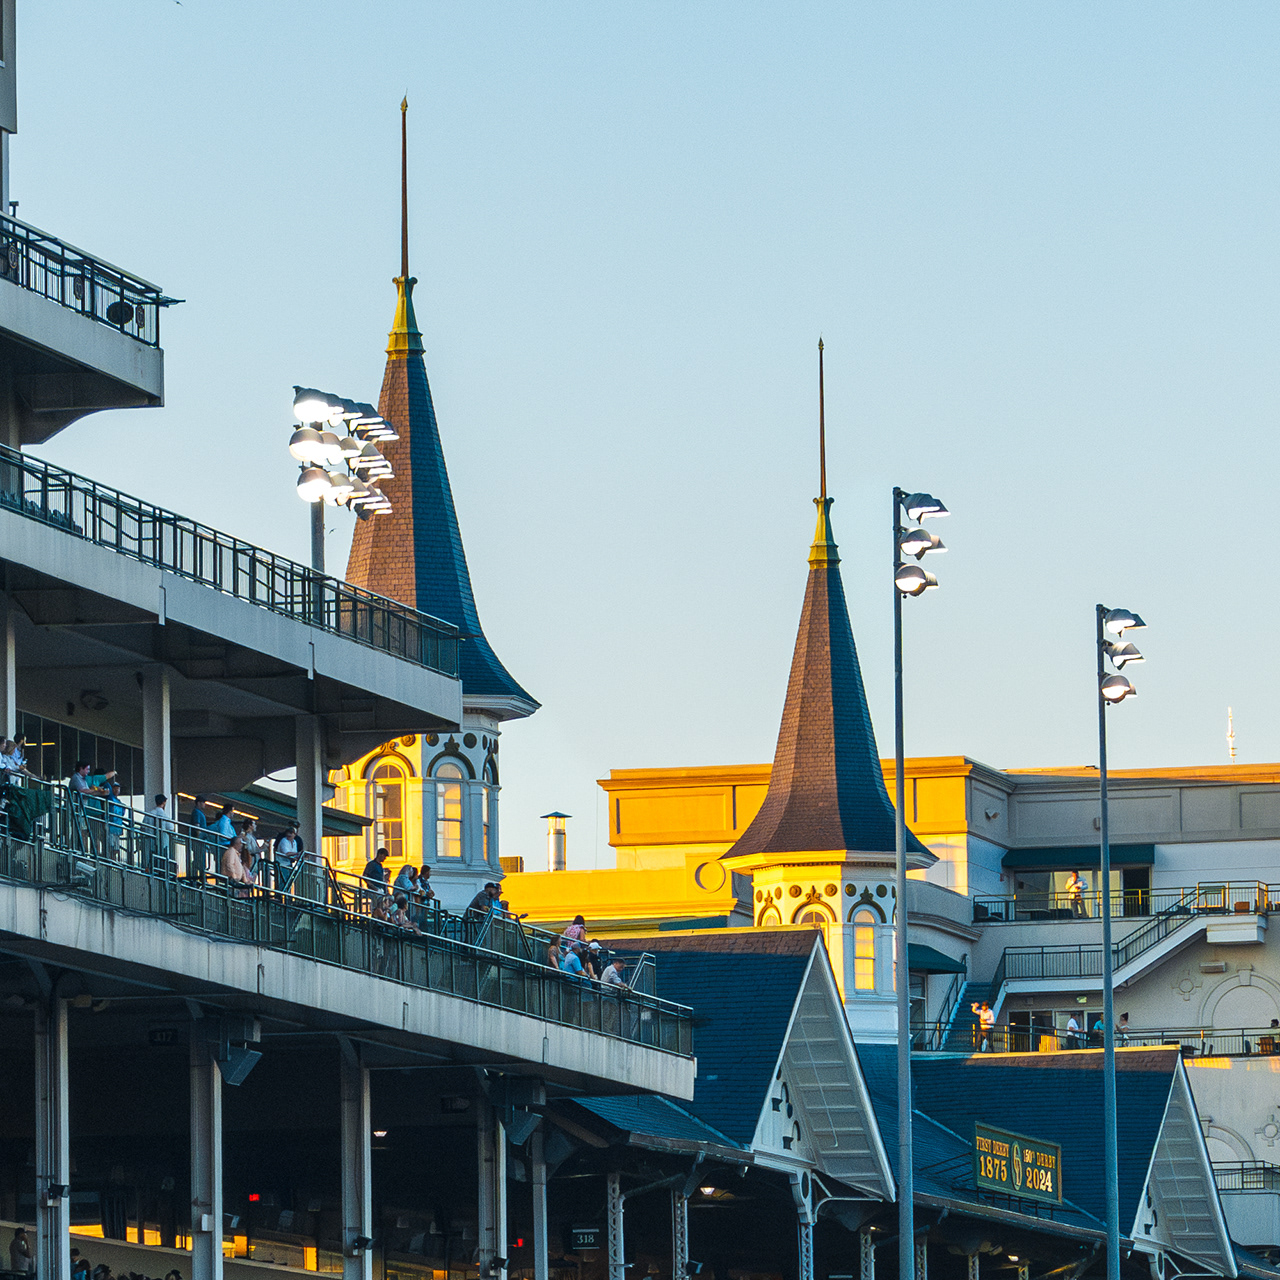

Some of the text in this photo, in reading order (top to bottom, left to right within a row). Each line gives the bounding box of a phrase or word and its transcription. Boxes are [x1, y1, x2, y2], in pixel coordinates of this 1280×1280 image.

[976, 1136, 1010, 1158] FIRST DERBY
[980, 1155, 1007, 1182] 1875
[1036, 1152, 1056, 1169] DERBY
[1026, 1167, 1053, 1192] 2024
[576, 1234, 595, 1244] 318
